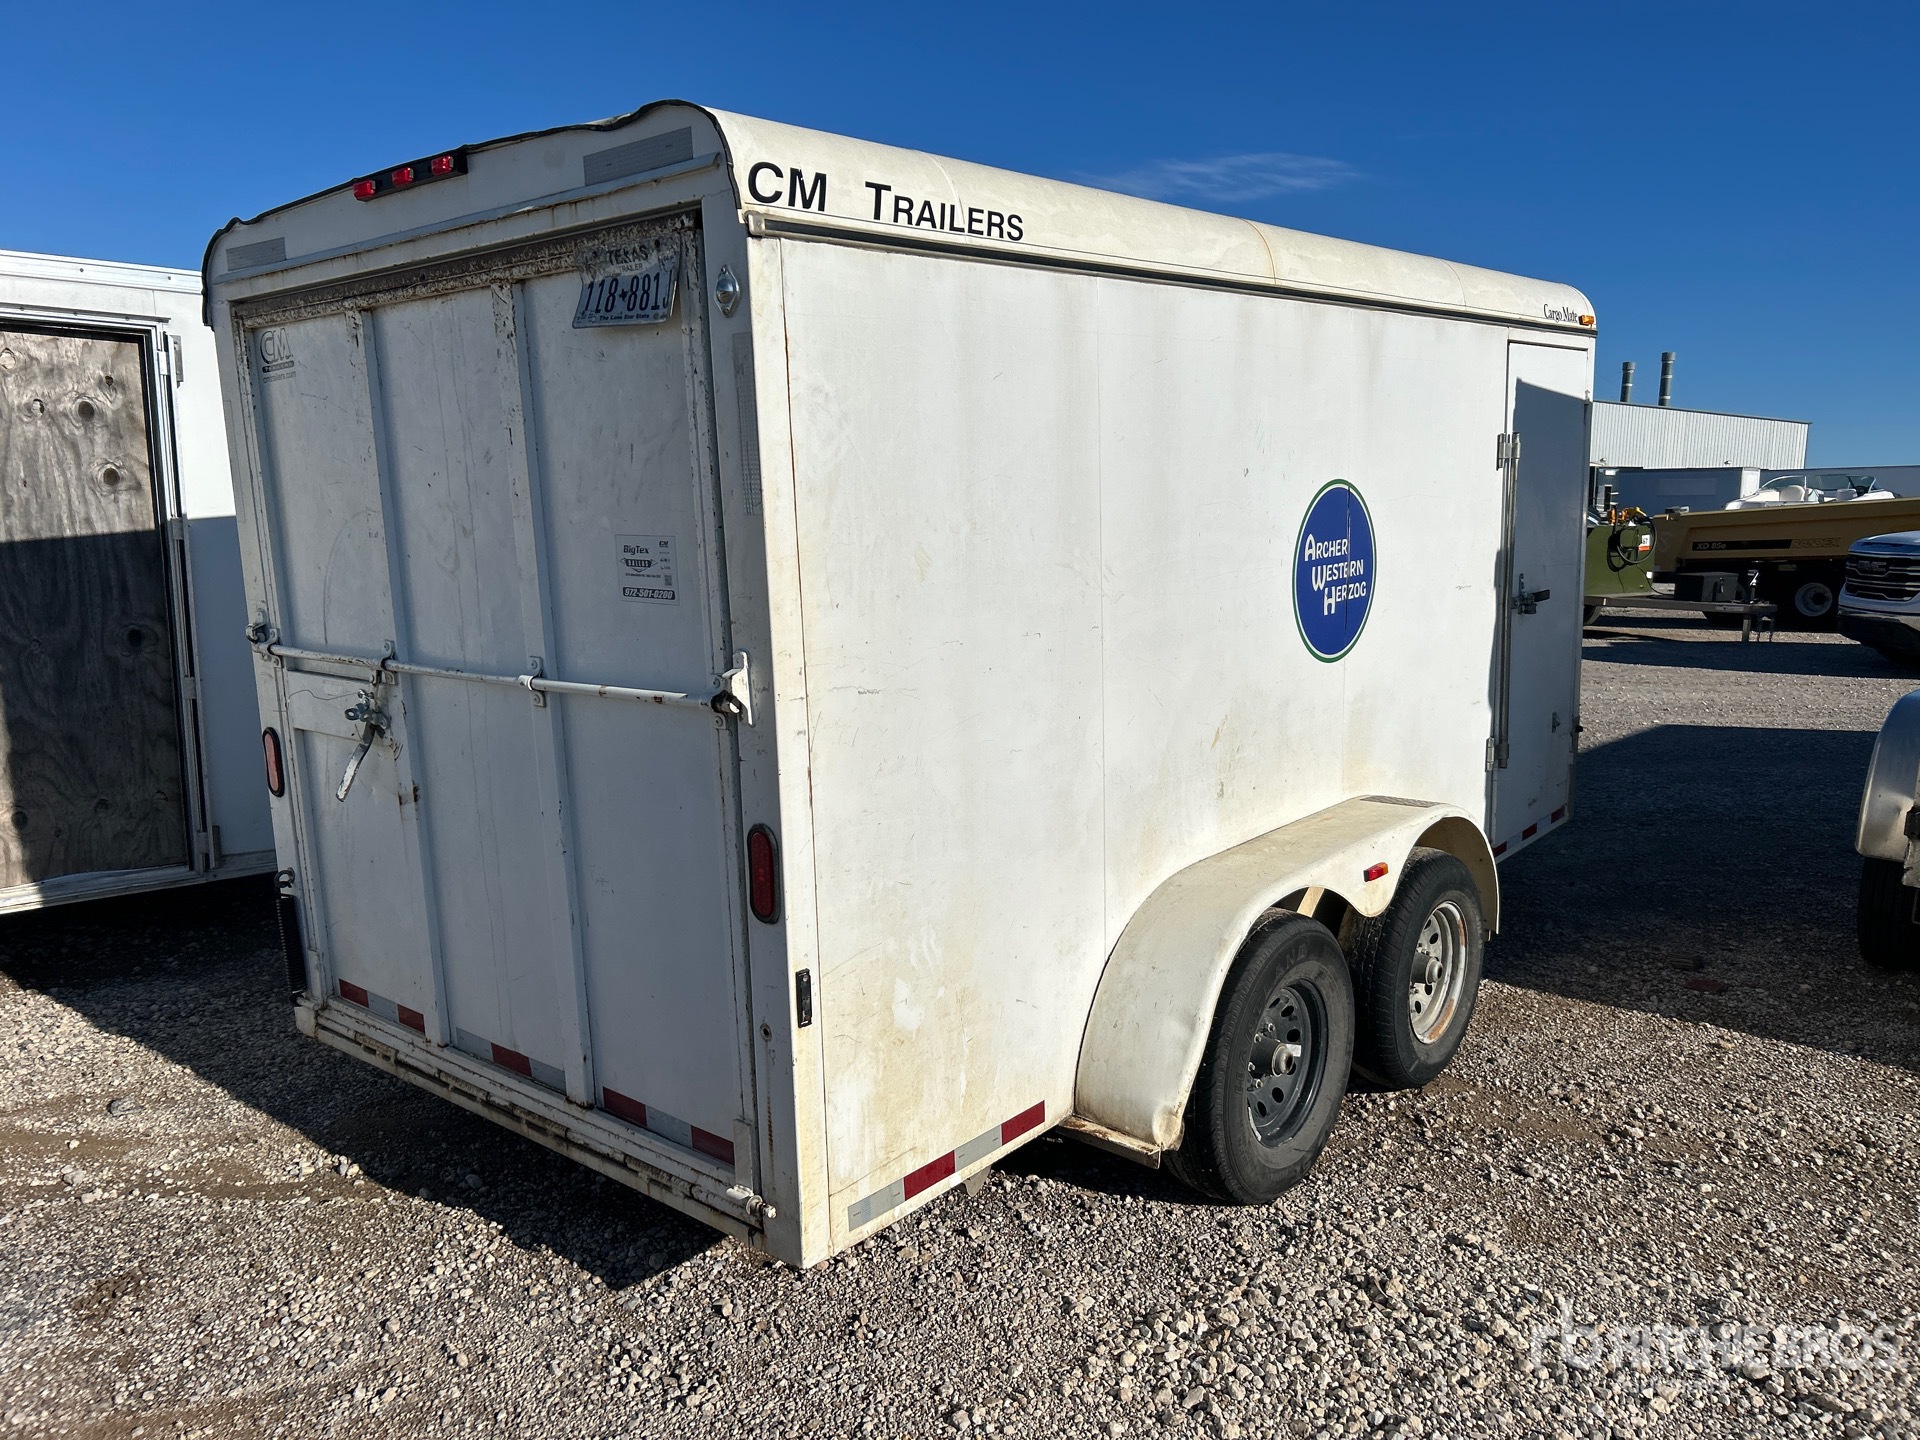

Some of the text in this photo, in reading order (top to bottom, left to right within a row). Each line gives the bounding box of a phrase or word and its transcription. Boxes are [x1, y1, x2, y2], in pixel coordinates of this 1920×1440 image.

[748, 162, 1024, 241] CM TRAILERS
[607, 244, 649, 266] TEXAS
[1544, 304, 1578, 323] Cargo Mate
[260, 328, 294, 364] CM
[623, 544, 650, 556] BigTex
[1304, 533, 1349, 562] ARCHER
[1311, 559, 1364, 592] WESTERN
[624, 587, 673, 599] 972-501-0200
[1323, 581, 1367, 616] HERZOG
